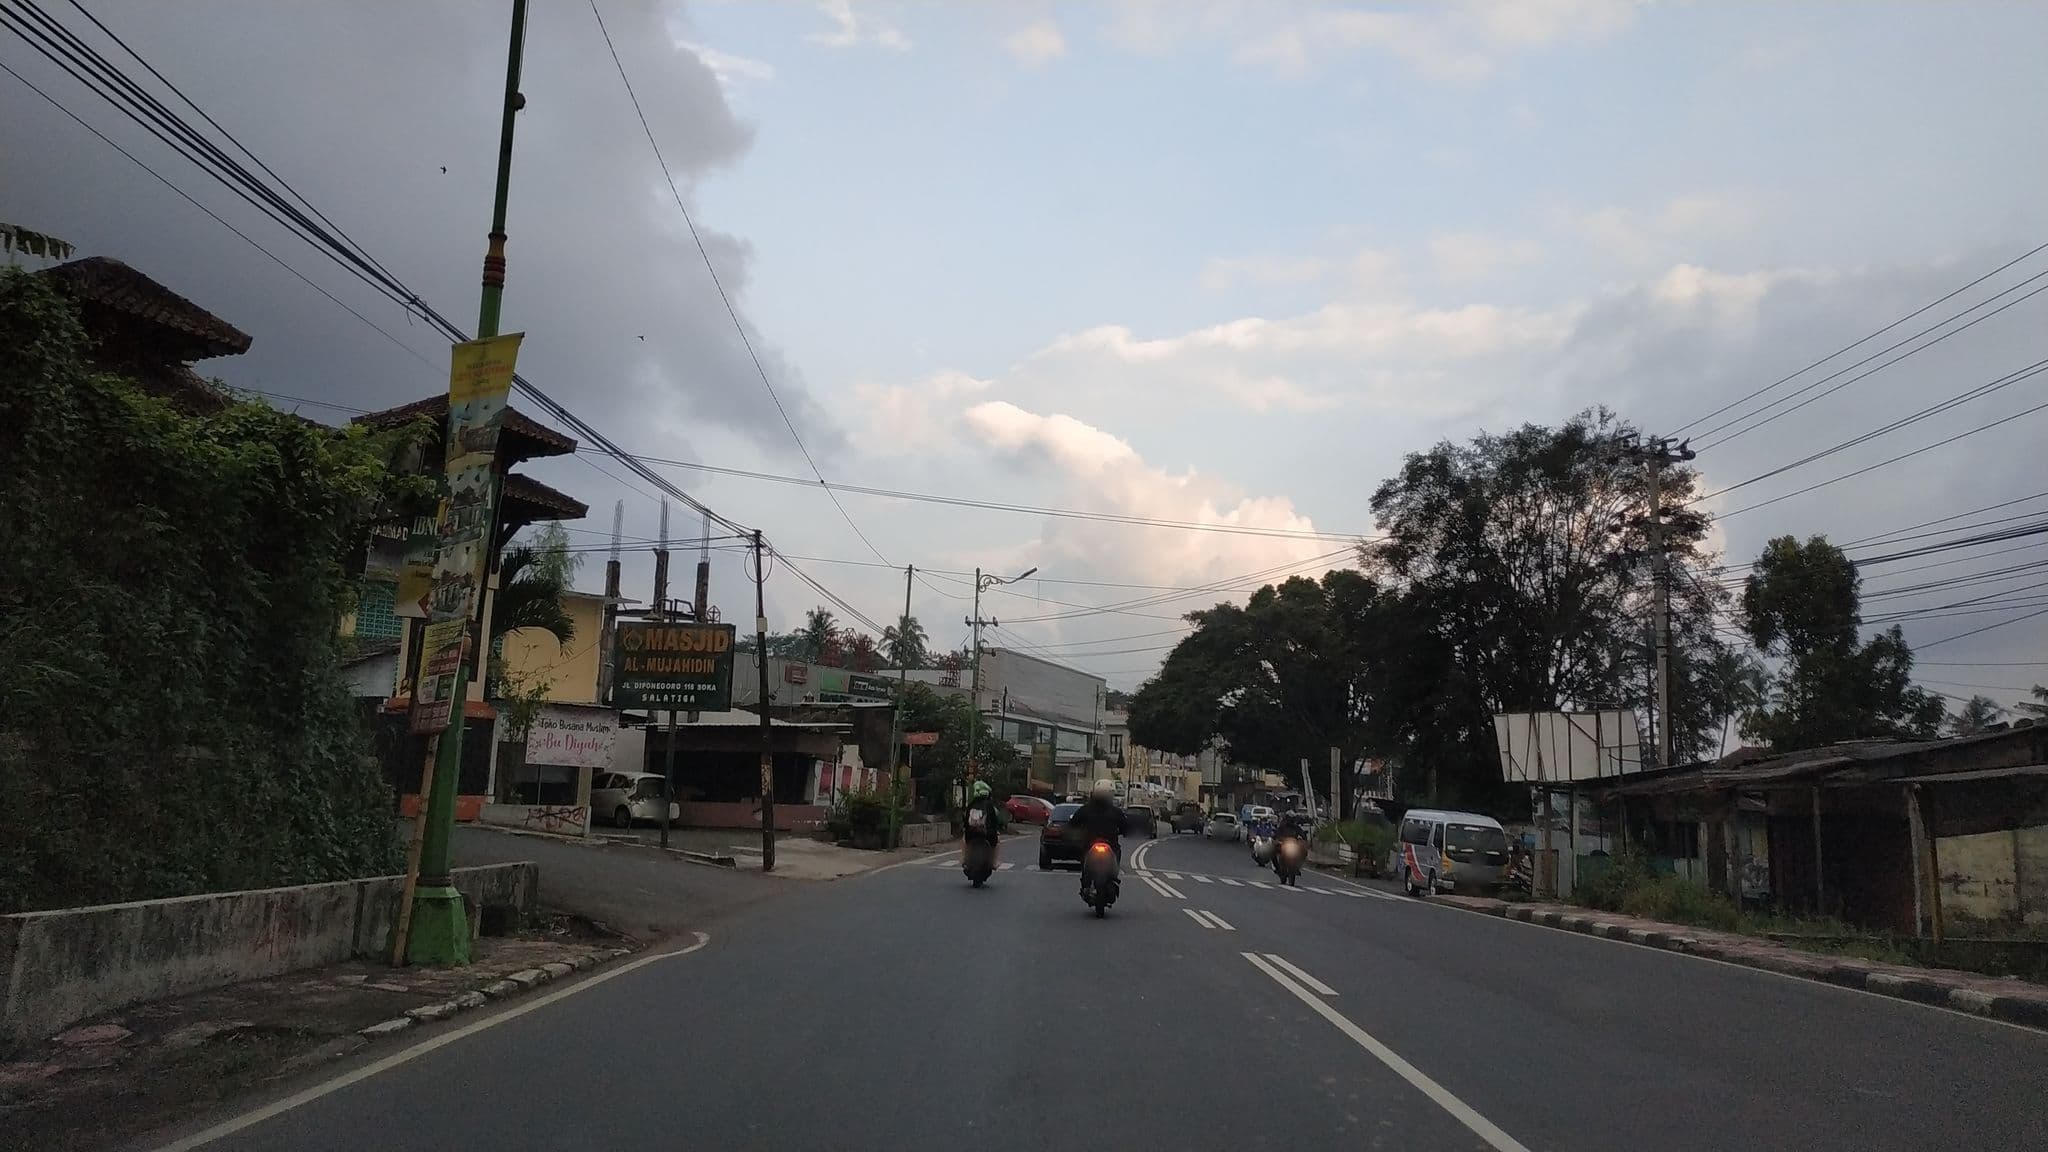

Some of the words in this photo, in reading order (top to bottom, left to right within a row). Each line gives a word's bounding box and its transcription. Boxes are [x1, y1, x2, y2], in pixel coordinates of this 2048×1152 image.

[646, 628, 730, 652] MASJID
[634, 682, 682, 690] DIPONEGORO
[697, 683, 717, 691] SOKA
[641, 693, 695, 703] SALATIGA
[541, 717, 558, 730] Toko
[559, 719, 584, 732] Busana
[586, 721, 611, 734] Muslim
[545, 732, 562, 750] Bu
